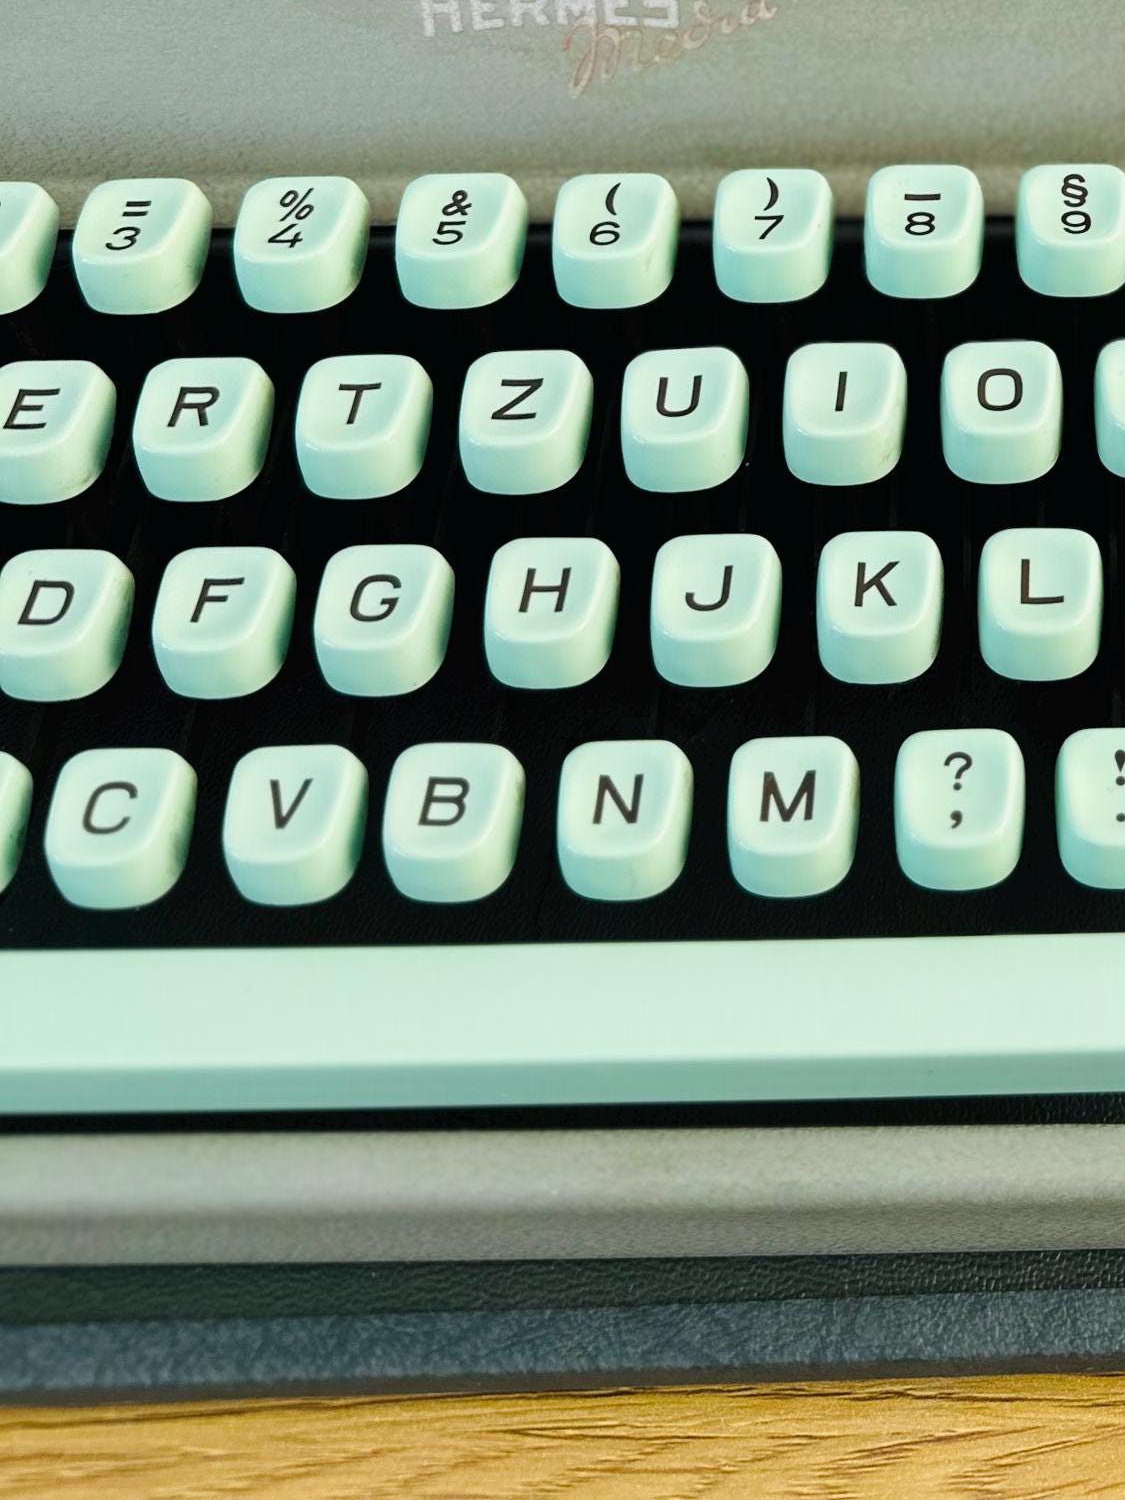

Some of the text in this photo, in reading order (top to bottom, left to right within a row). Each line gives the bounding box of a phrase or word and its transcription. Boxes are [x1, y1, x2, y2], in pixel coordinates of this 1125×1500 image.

[279, 187, 315, 222] %
[441, 189, 473, 217] &
[605, 182, 621, 216] (
[763, 177, 779, 212] )
[1060, 173, 1089, 208] §
[105, 226, 141, 251] 3
[267, 223, 303, 249] 4
[432, 220, 467, 246] 5
[589, 220, 621, 246] 6
[754, 214, 785, 240] 7
[904, 211, 936, 236] 8
[1060, 210, 1092, 235] 9
[2, 388, 61, 430] E
[166, 386, 220, 428] R
[338, 382, 382, 425] T
[490, 377, 544, 421] Z
[656, 374, 703, 418] U
[834, 371, 848, 412] I
[977, 368, 1024, 412] O
[17, 579, 75, 626] D
[189, 577, 245, 623] F
[349, 574, 402, 623] G
[518, 567, 572, 613] H
[684, 564, 734, 612] J
[854, 560, 900, 608] K
[1020, 558, 1065, 605] L
[943, 751, 973, 791] ?
[82, 781, 138, 835] C
[269, 778, 313, 830] V
[418, 776, 470, 827] B
[592, 773, 644, 825] N
[759, 769, 817, 823] M
